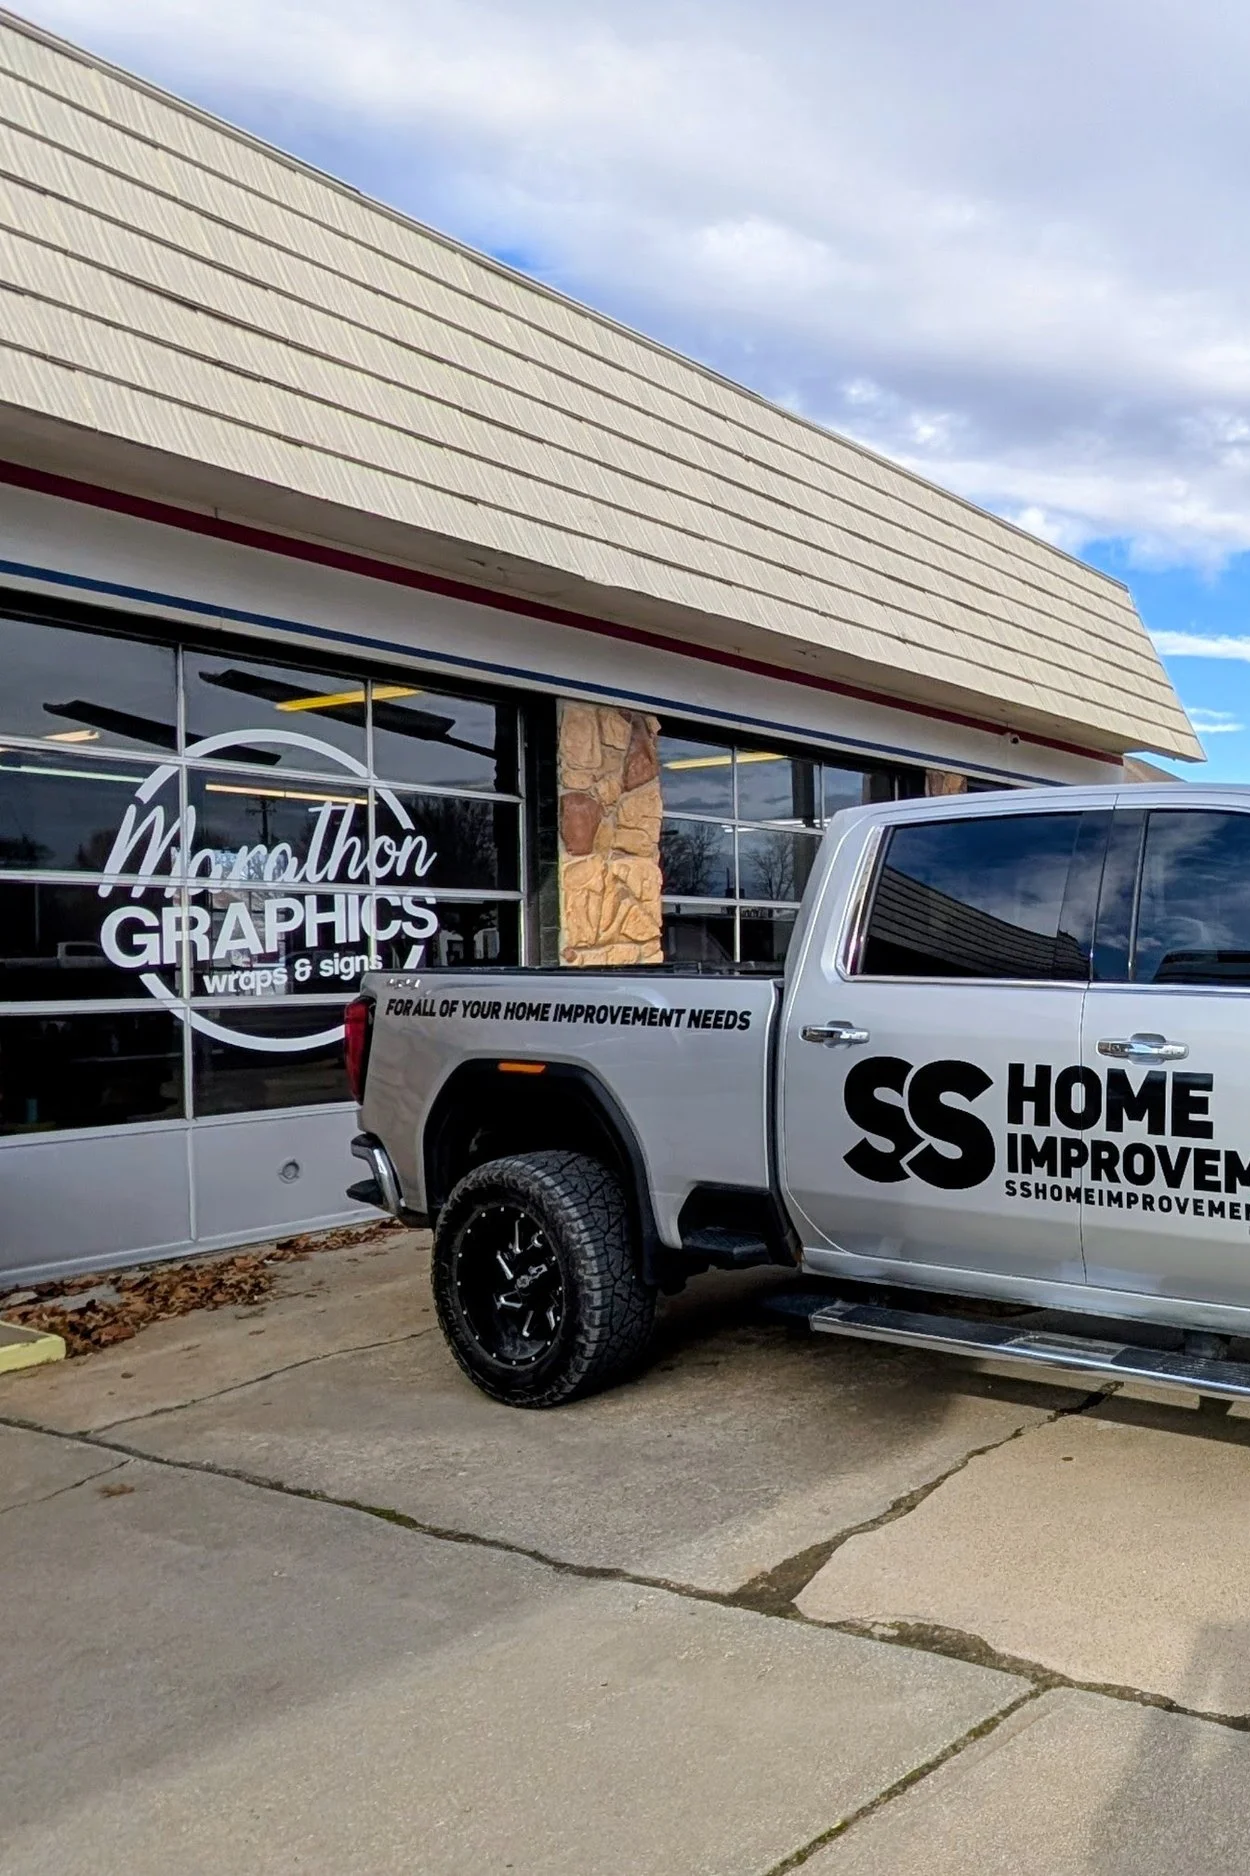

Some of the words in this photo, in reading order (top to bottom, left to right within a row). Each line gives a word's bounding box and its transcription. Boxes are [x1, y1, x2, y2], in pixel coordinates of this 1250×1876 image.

[97, 800, 437, 899] Marathon
[100, 890, 438, 969] GRAPHICS
[203, 966, 287, 995] wraps
[294, 958, 312, 982] &
[320, 951, 384, 980] signs
[385, 998, 414, 1017] FOR
[411, 999, 437, 1018] ALL
[439, 999, 459, 1018] OF
[461, 1000, 501, 1020] YOUR
[503, 1001, 552, 1022] HOME
[552, 1003, 687, 1029] IMPROVEMENT
[686, 1008, 753, 1031] NEEDS
[843, 1055, 997, 1191] SS
[1006, 1062, 1214, 1140] HOME
